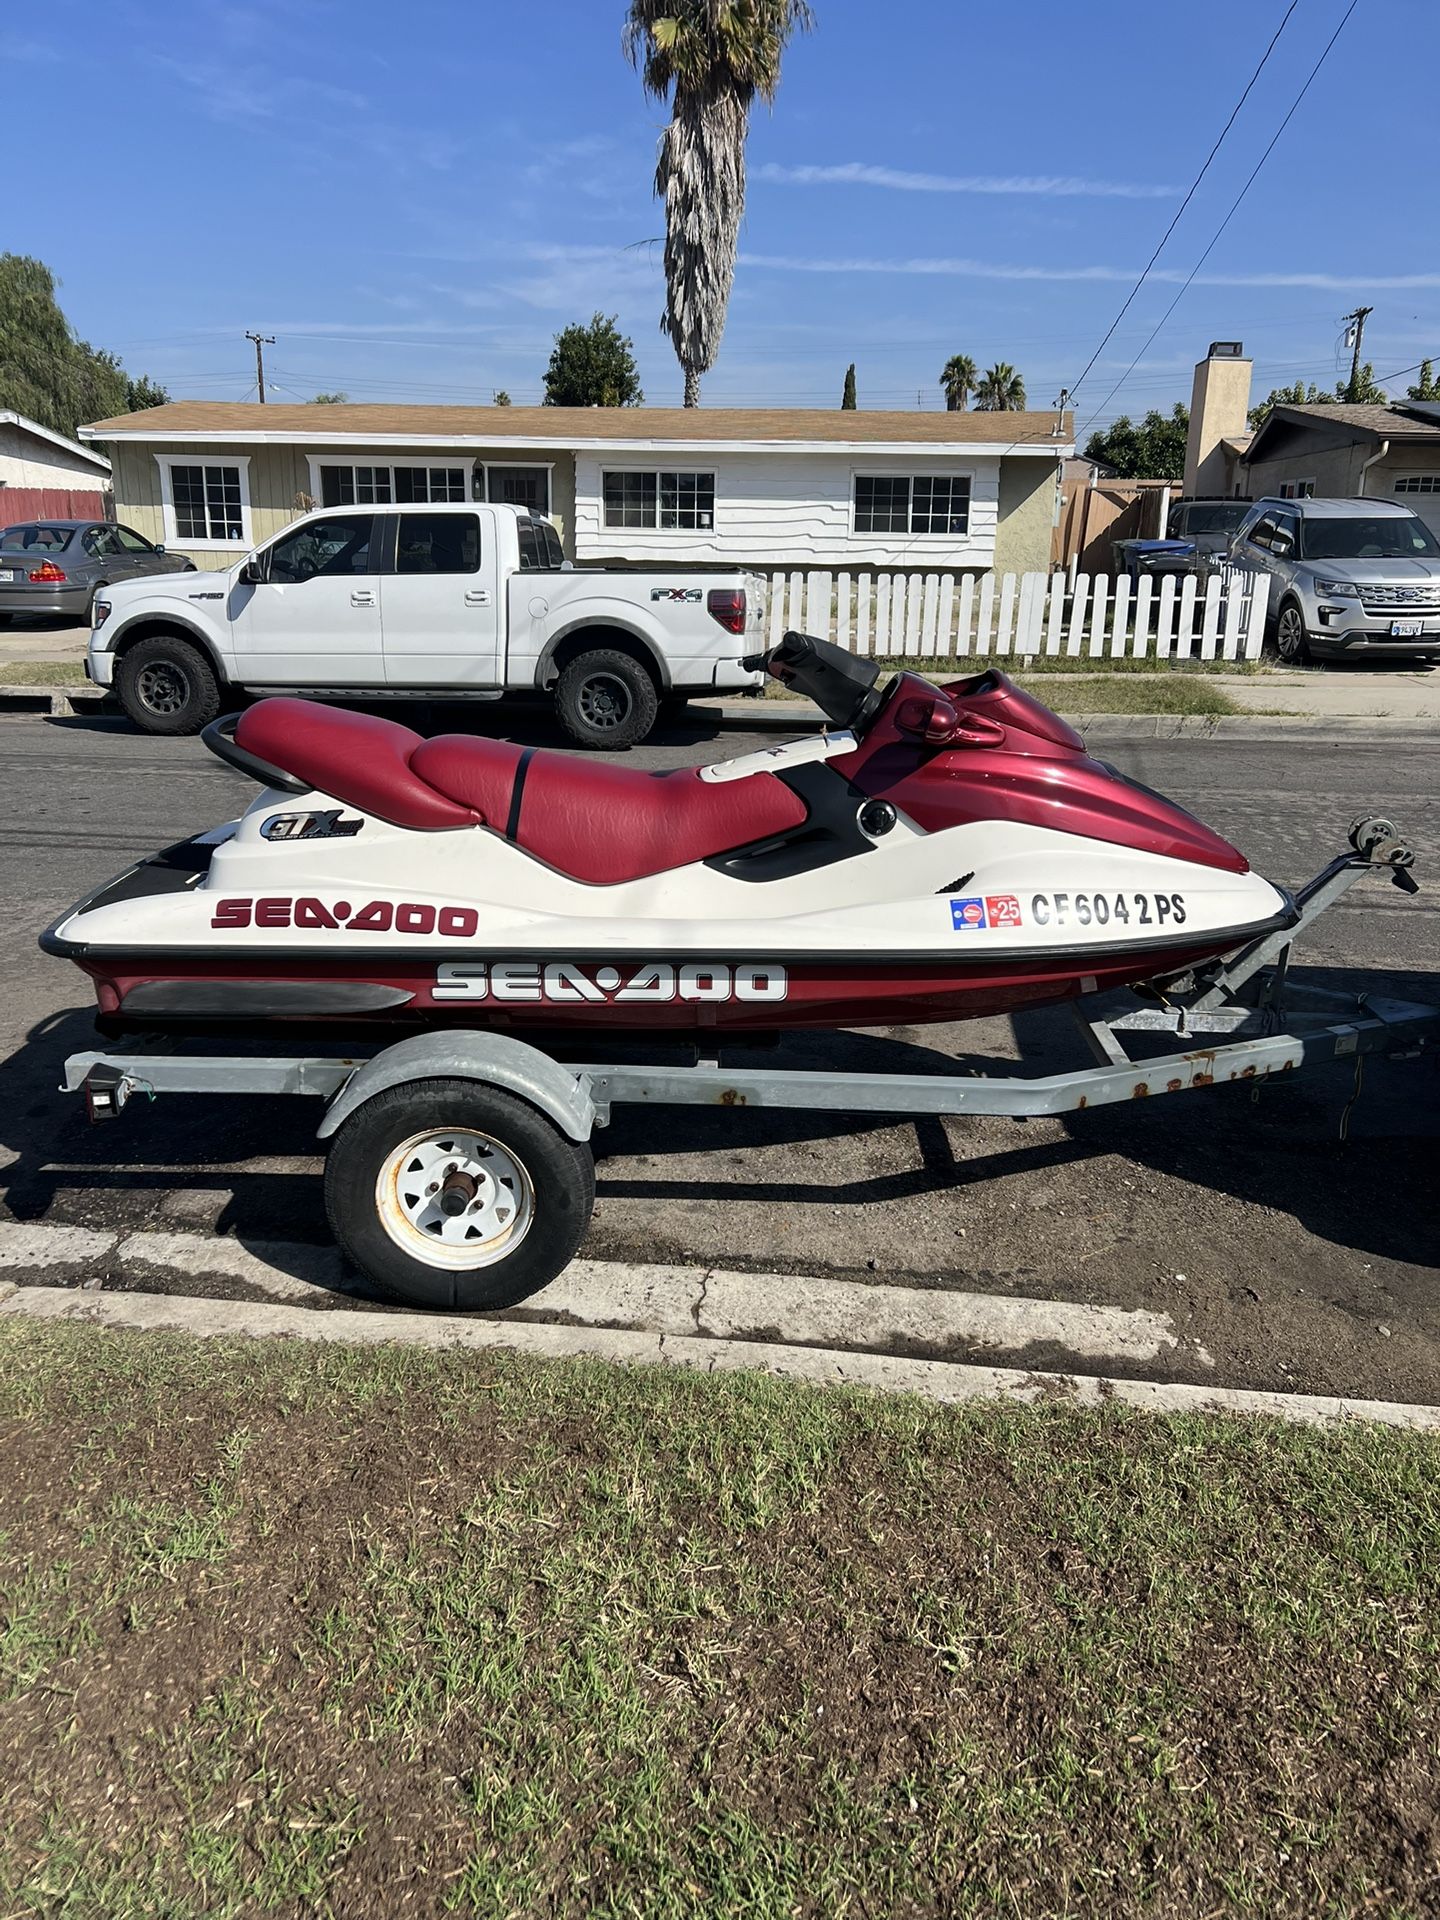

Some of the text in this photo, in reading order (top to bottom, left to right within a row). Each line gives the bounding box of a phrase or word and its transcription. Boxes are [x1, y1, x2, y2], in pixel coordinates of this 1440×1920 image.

[651, 588, 702, 601] FX4
[260, 810, 344, 836] GTX
[997, 901, 1020, 919] 25
